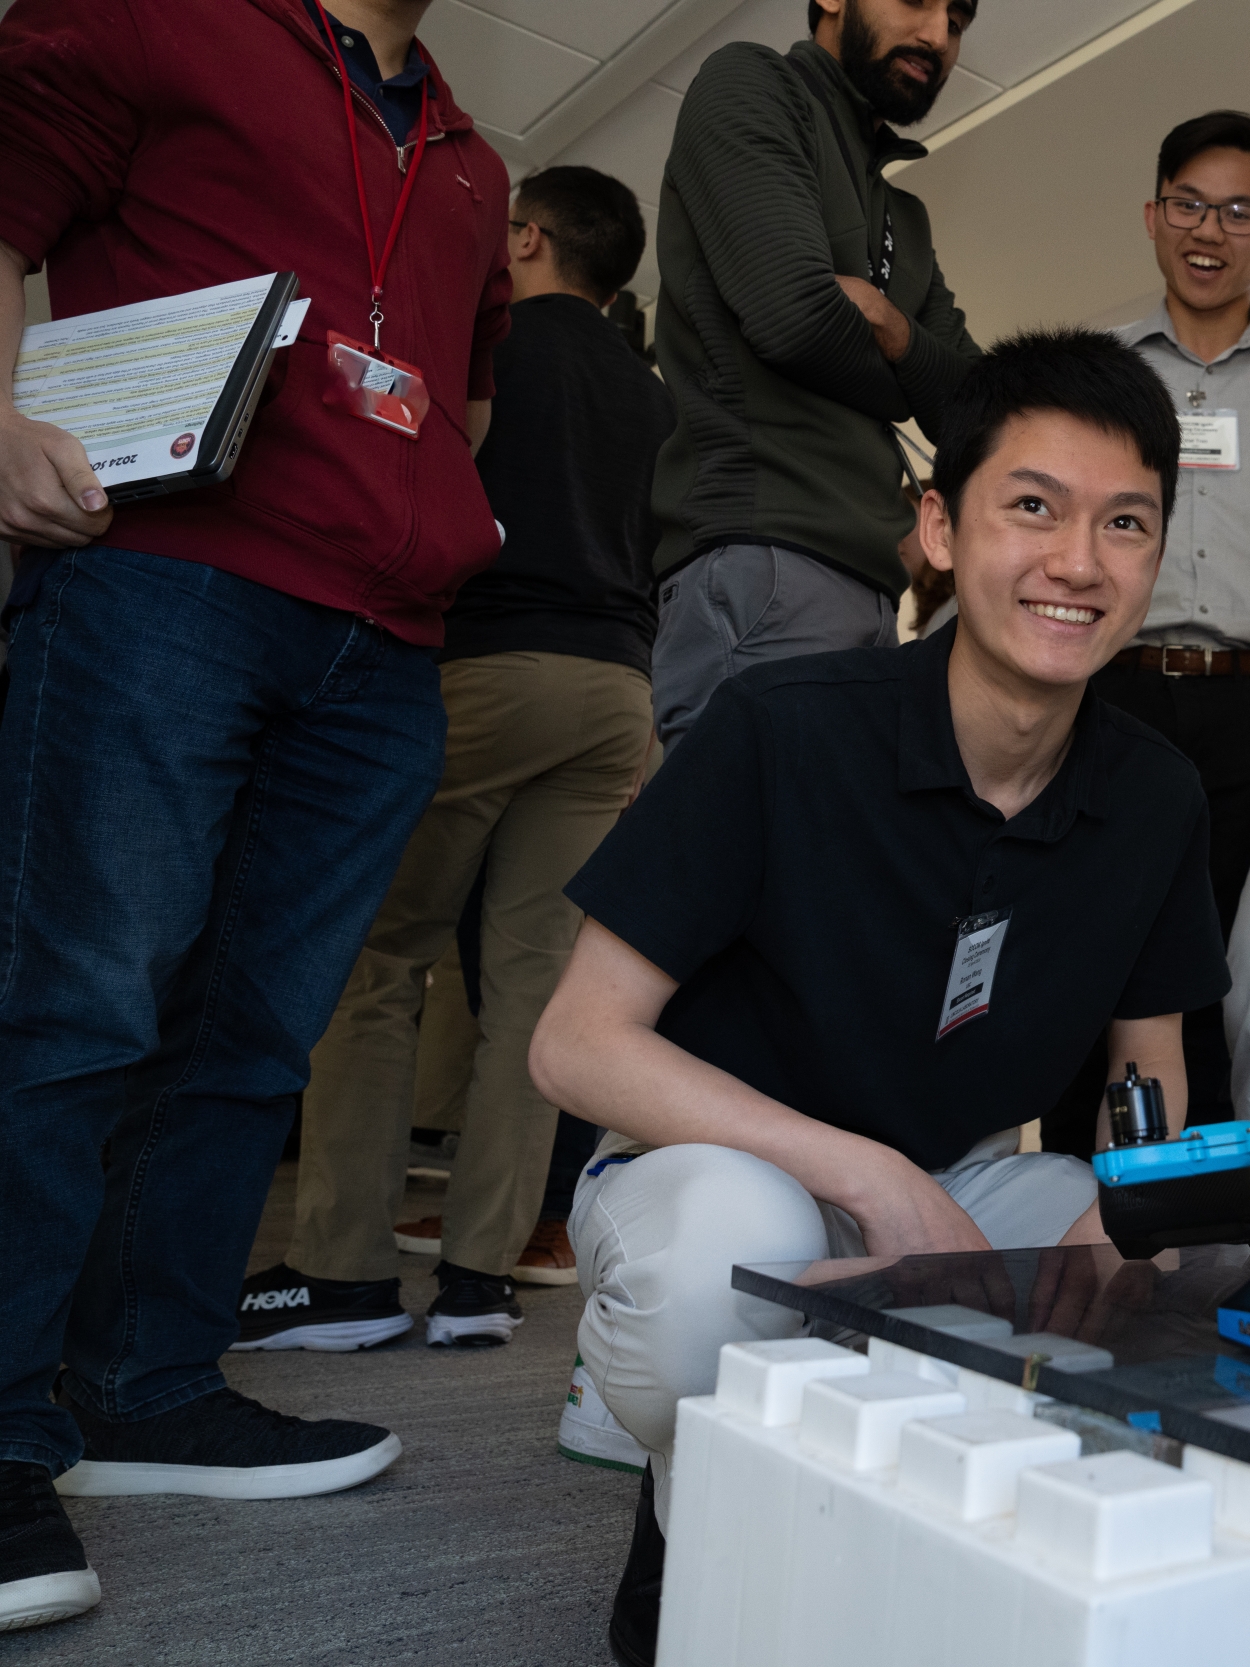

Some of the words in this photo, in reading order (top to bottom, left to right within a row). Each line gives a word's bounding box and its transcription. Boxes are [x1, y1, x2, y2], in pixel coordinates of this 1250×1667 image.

[90, 460, 107, 471] SO
[109, 454, 138, 468] 2024
[241, 1287, 310, 1311] HOKA
